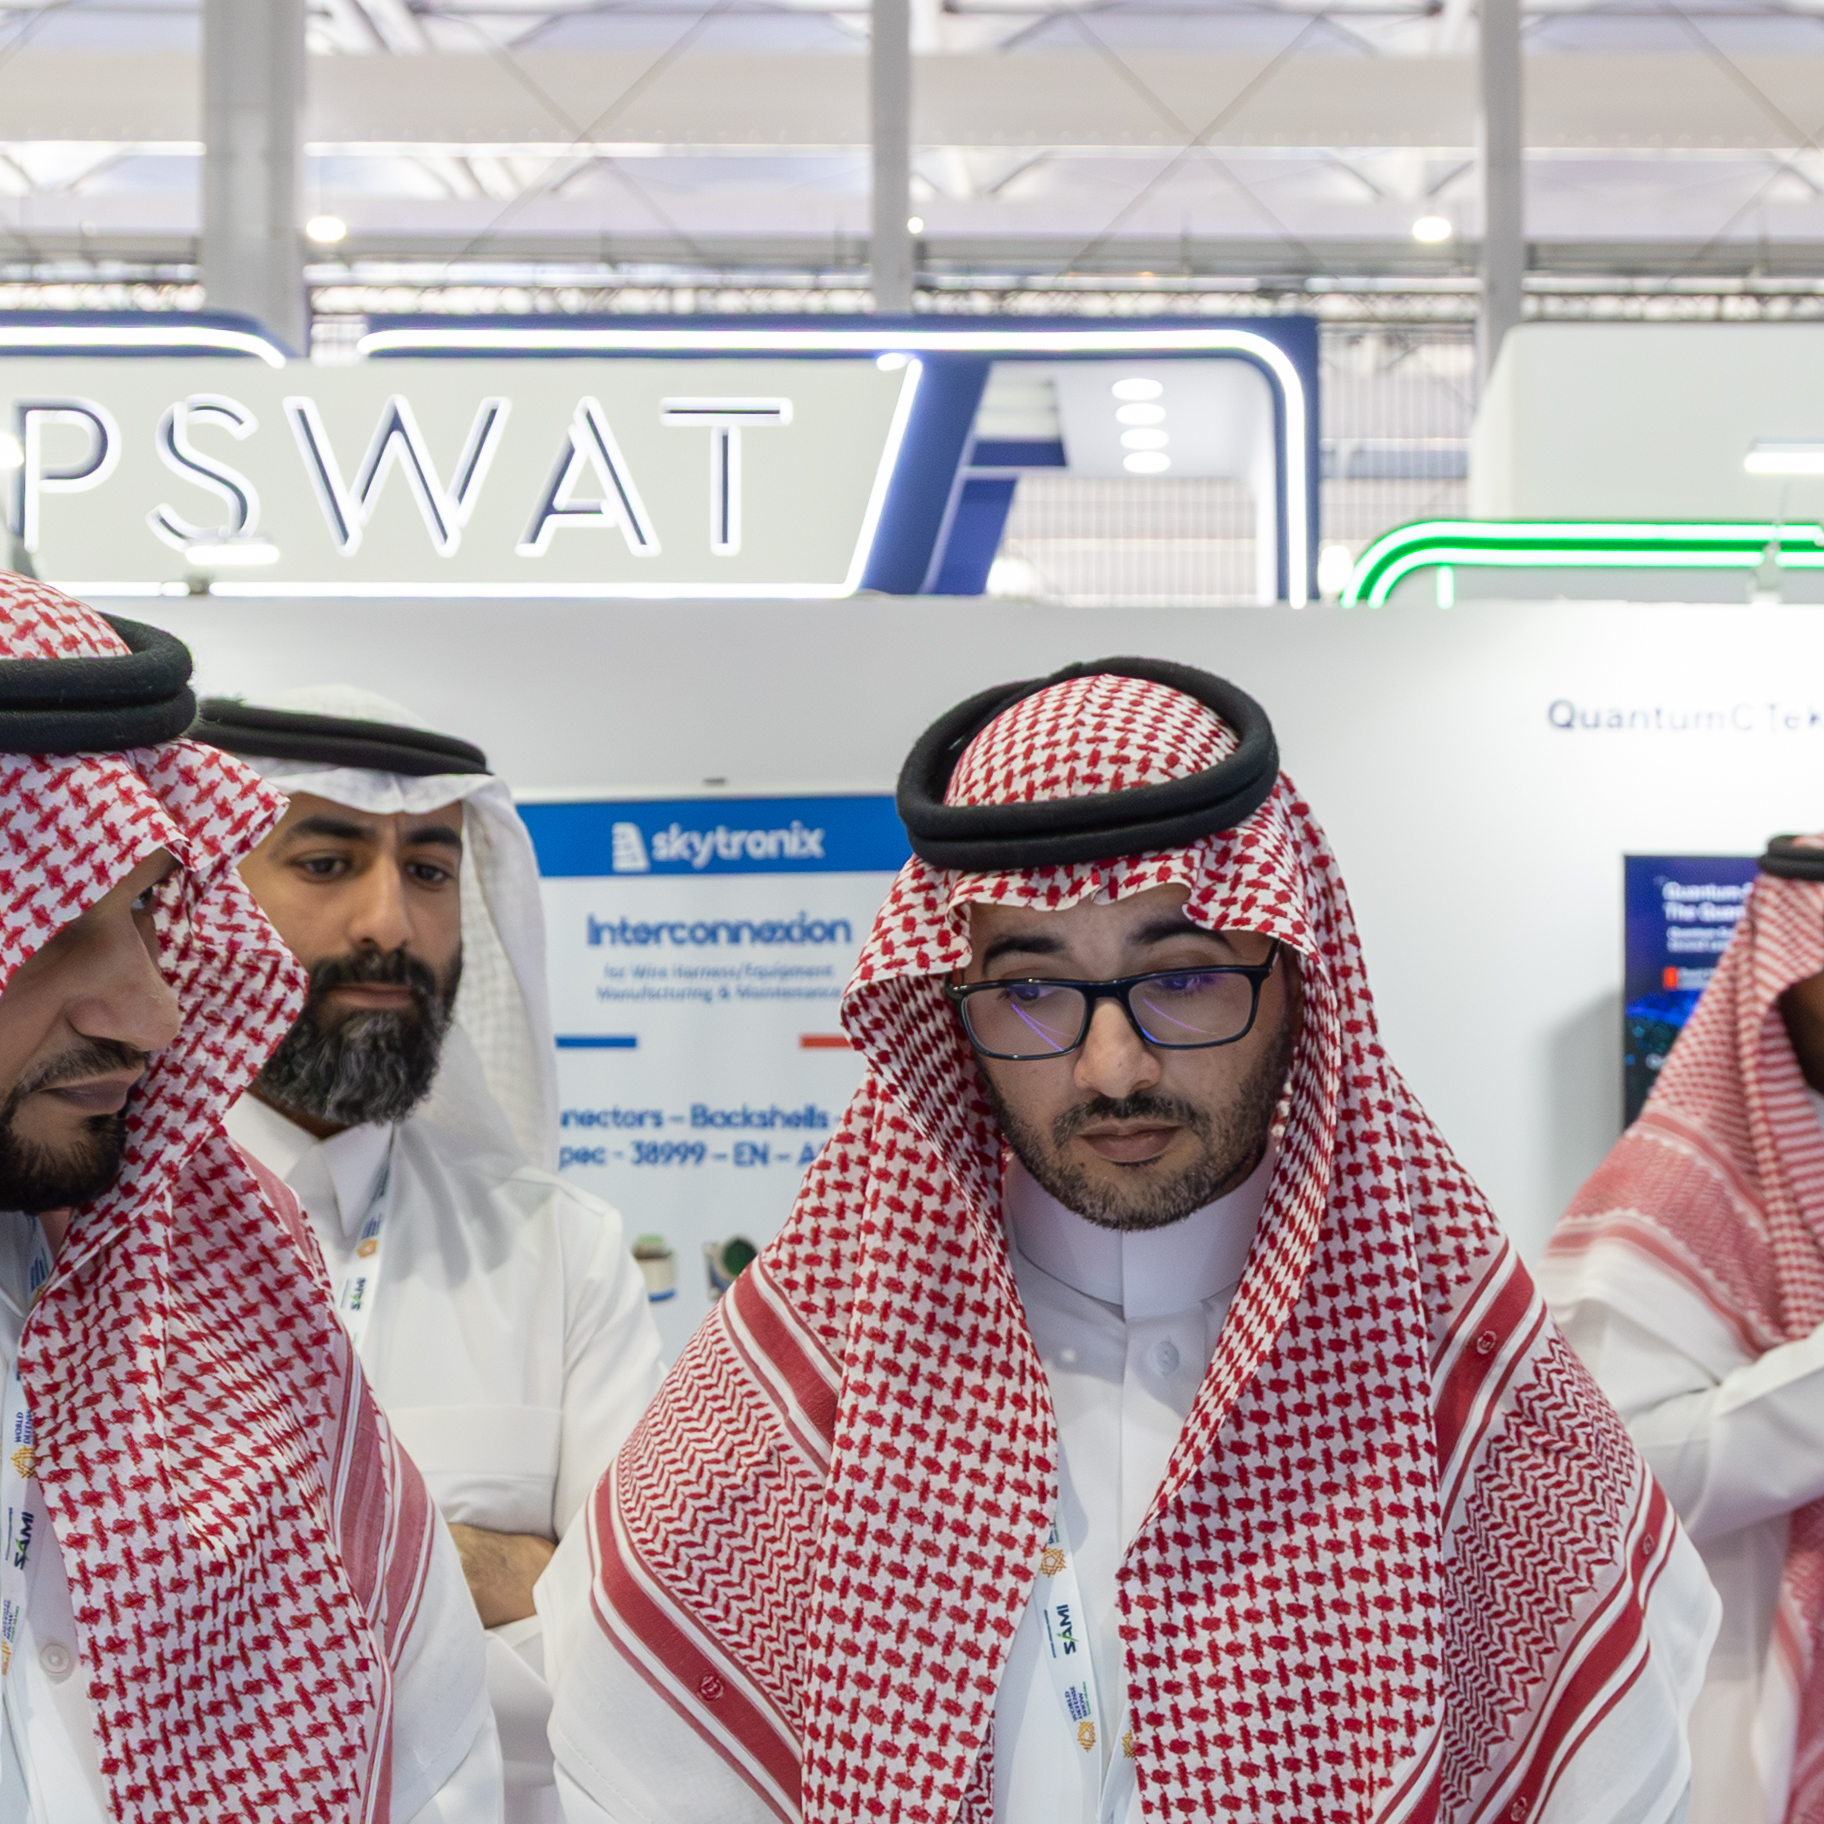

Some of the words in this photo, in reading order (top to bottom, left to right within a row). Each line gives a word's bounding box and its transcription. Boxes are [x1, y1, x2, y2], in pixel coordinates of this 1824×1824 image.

[651, 819, 826, 870] skytronix
[587, 909, 853, 946] Interconnexion
[690, 1103, 829, 1129] Backshells
[629, 1140, 707, 1167] 38999
[733, 1141, 770, 1167] EN
[15, 1510, 35, 1571] SAMI
[1056, 1603, 1079, 1656] SAMI
